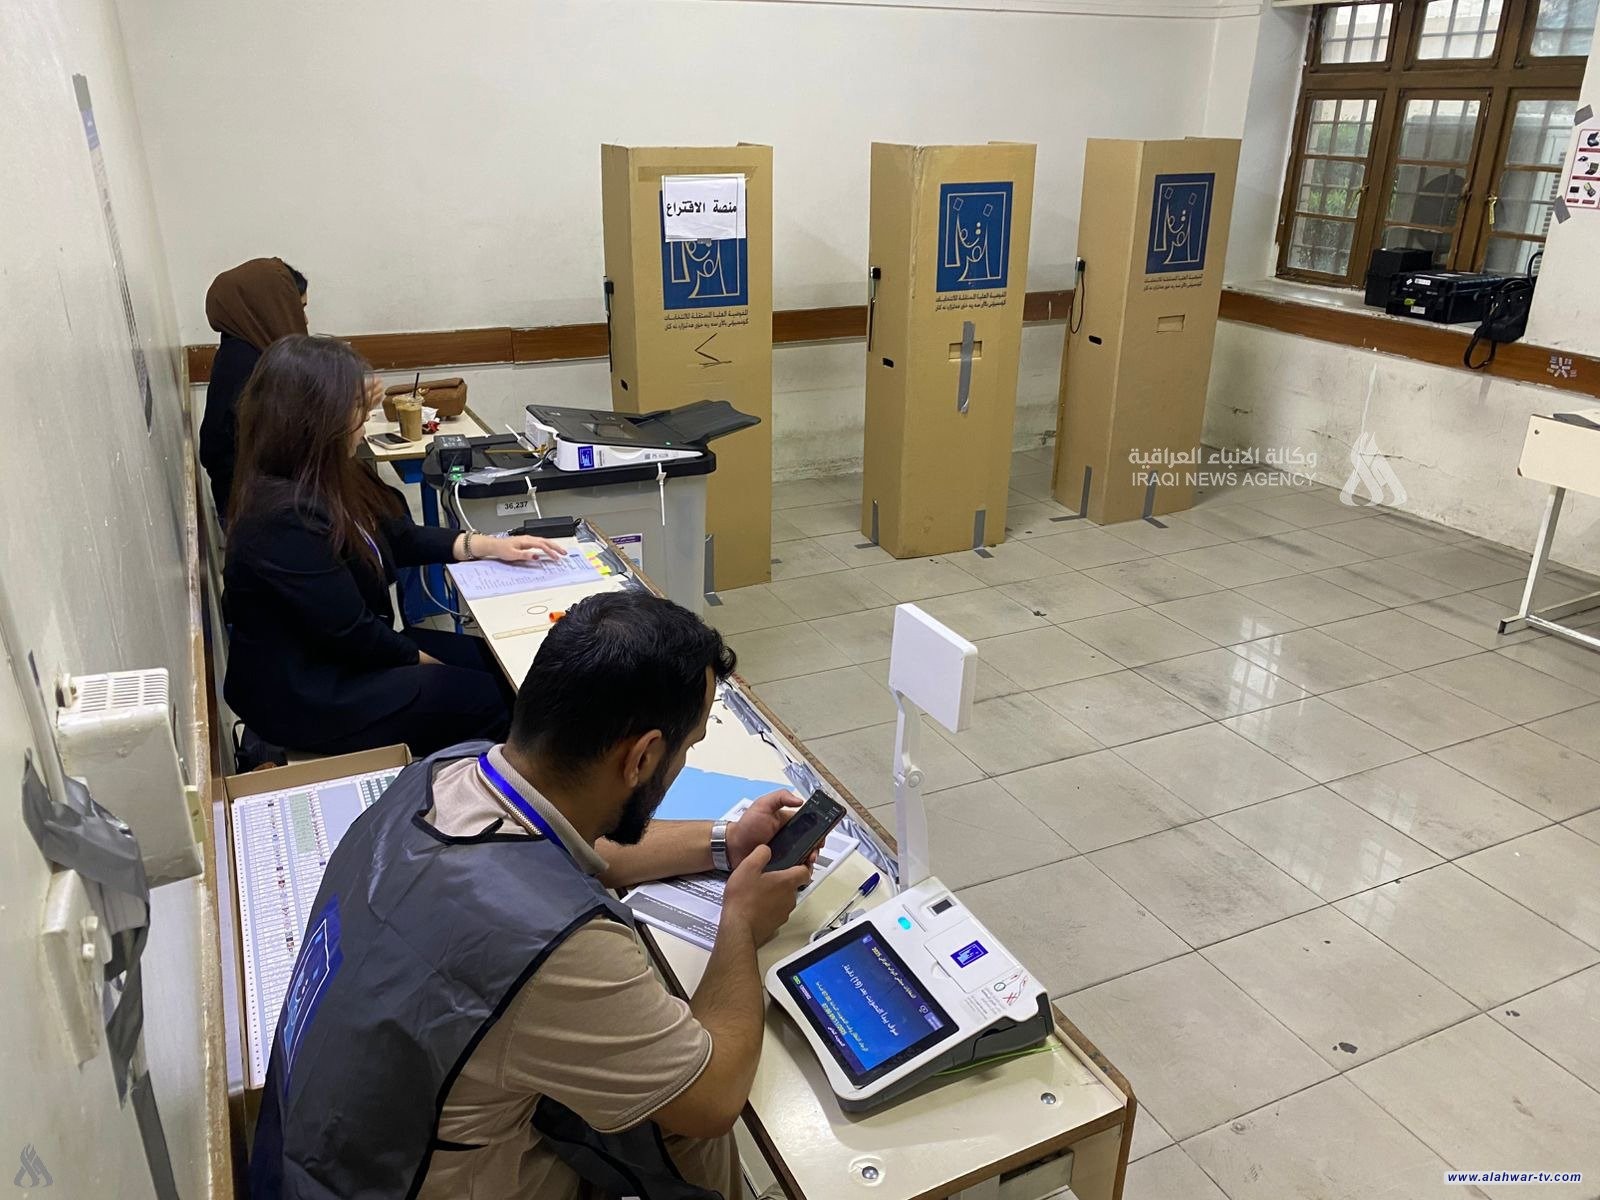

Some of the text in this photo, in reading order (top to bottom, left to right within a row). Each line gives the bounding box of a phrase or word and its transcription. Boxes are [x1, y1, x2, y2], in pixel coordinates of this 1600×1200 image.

[666, 200, 737, 217] منصة الاقتراع
[504, 500, 528, 510] 36,237
[864, 994, 883, 1014] التصويت
